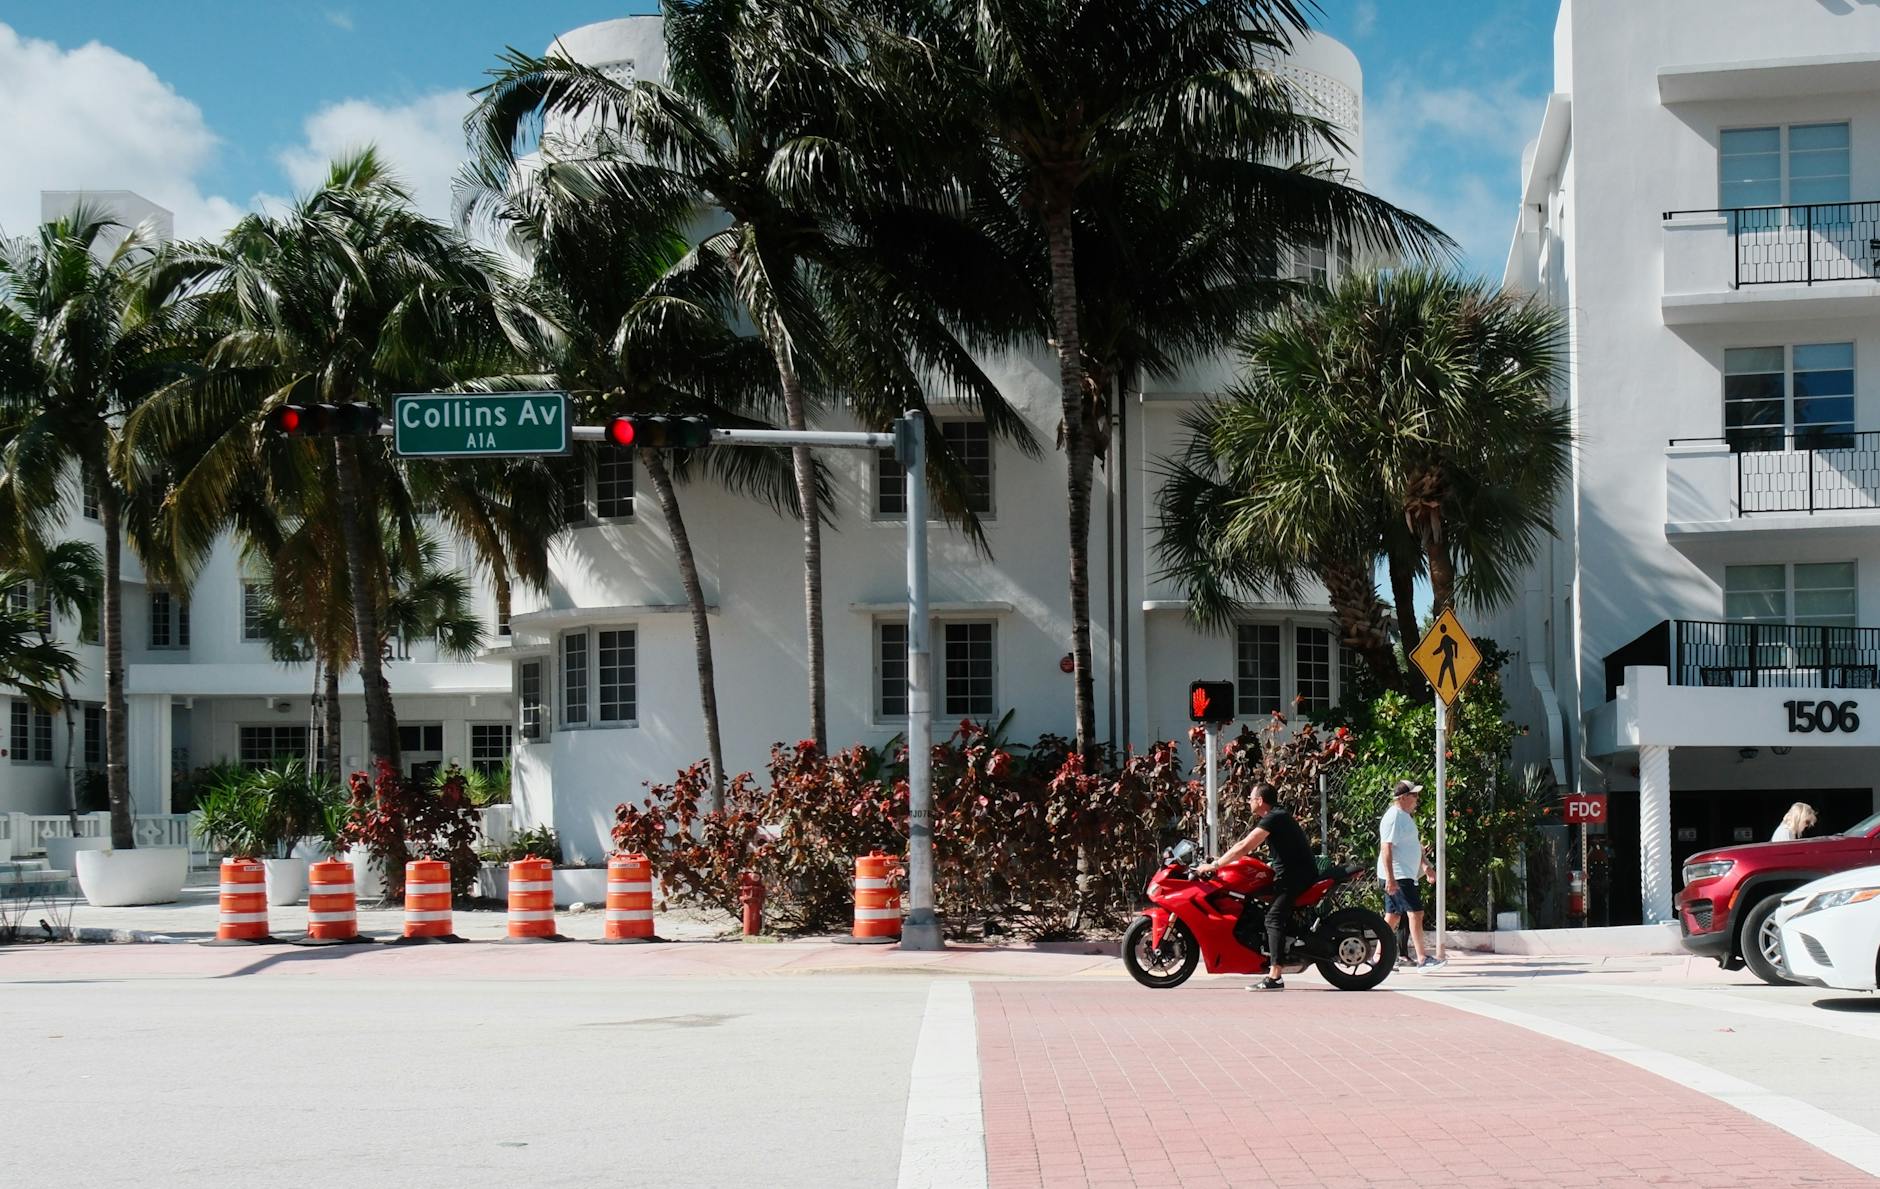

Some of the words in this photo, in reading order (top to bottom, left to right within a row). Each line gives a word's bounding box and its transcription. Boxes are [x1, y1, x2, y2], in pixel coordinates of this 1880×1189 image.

[402, 401, 507, 429] Collins
[517, 399, 558, 426] Av
[466, 432, 497, 449] A1A
[1783, 700, 1860, 733] 1506
[1569, 801, 1601, 817] FDC
